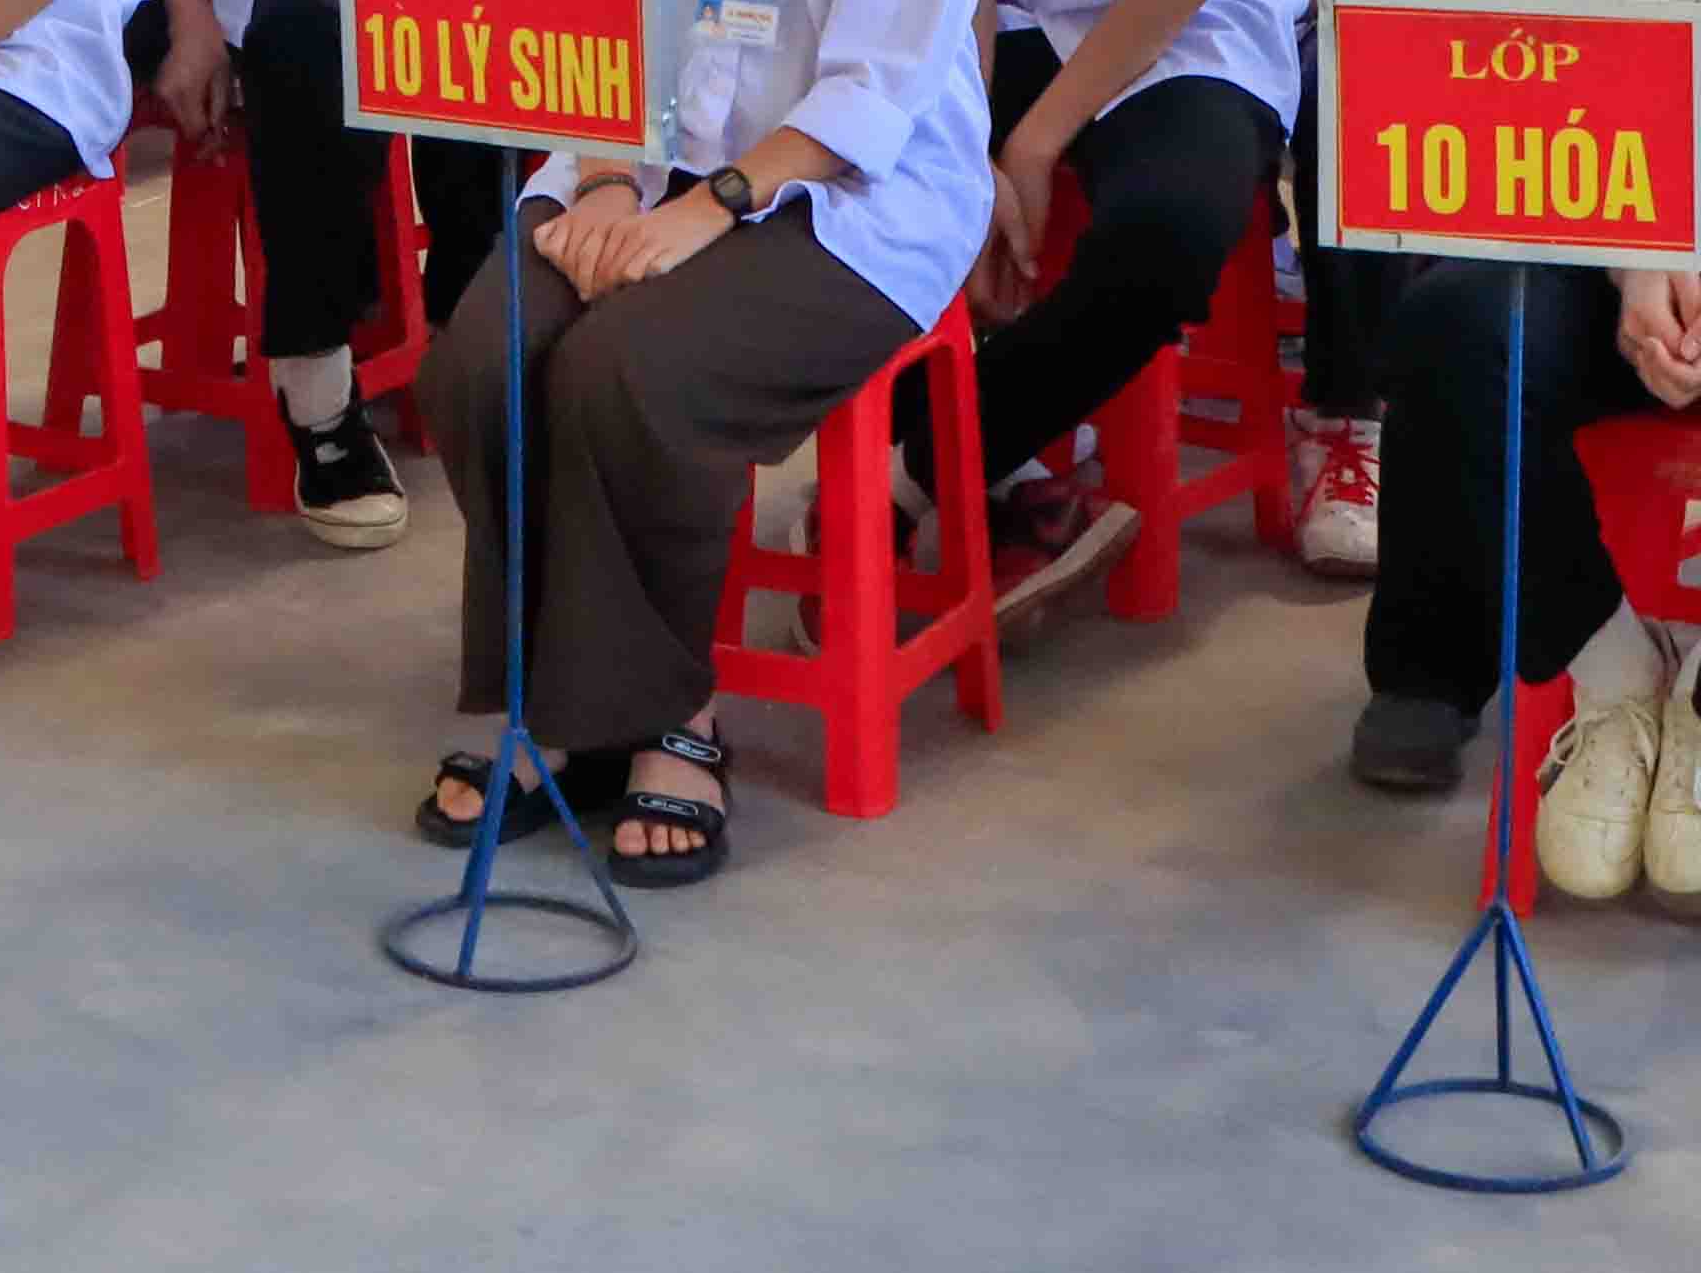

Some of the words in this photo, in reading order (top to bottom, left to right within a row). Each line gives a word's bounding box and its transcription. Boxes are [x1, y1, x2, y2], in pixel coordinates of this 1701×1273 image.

[365, 13, 422, 96] 10
[436, 4, 492, 104] LÝ
[509, 28, 632, 122] SINH
[1449, 28, 1580, 82] LỚP
[1376, 122, 1467, 215] 10
[1495, 108, 1657, 223] HÓA
